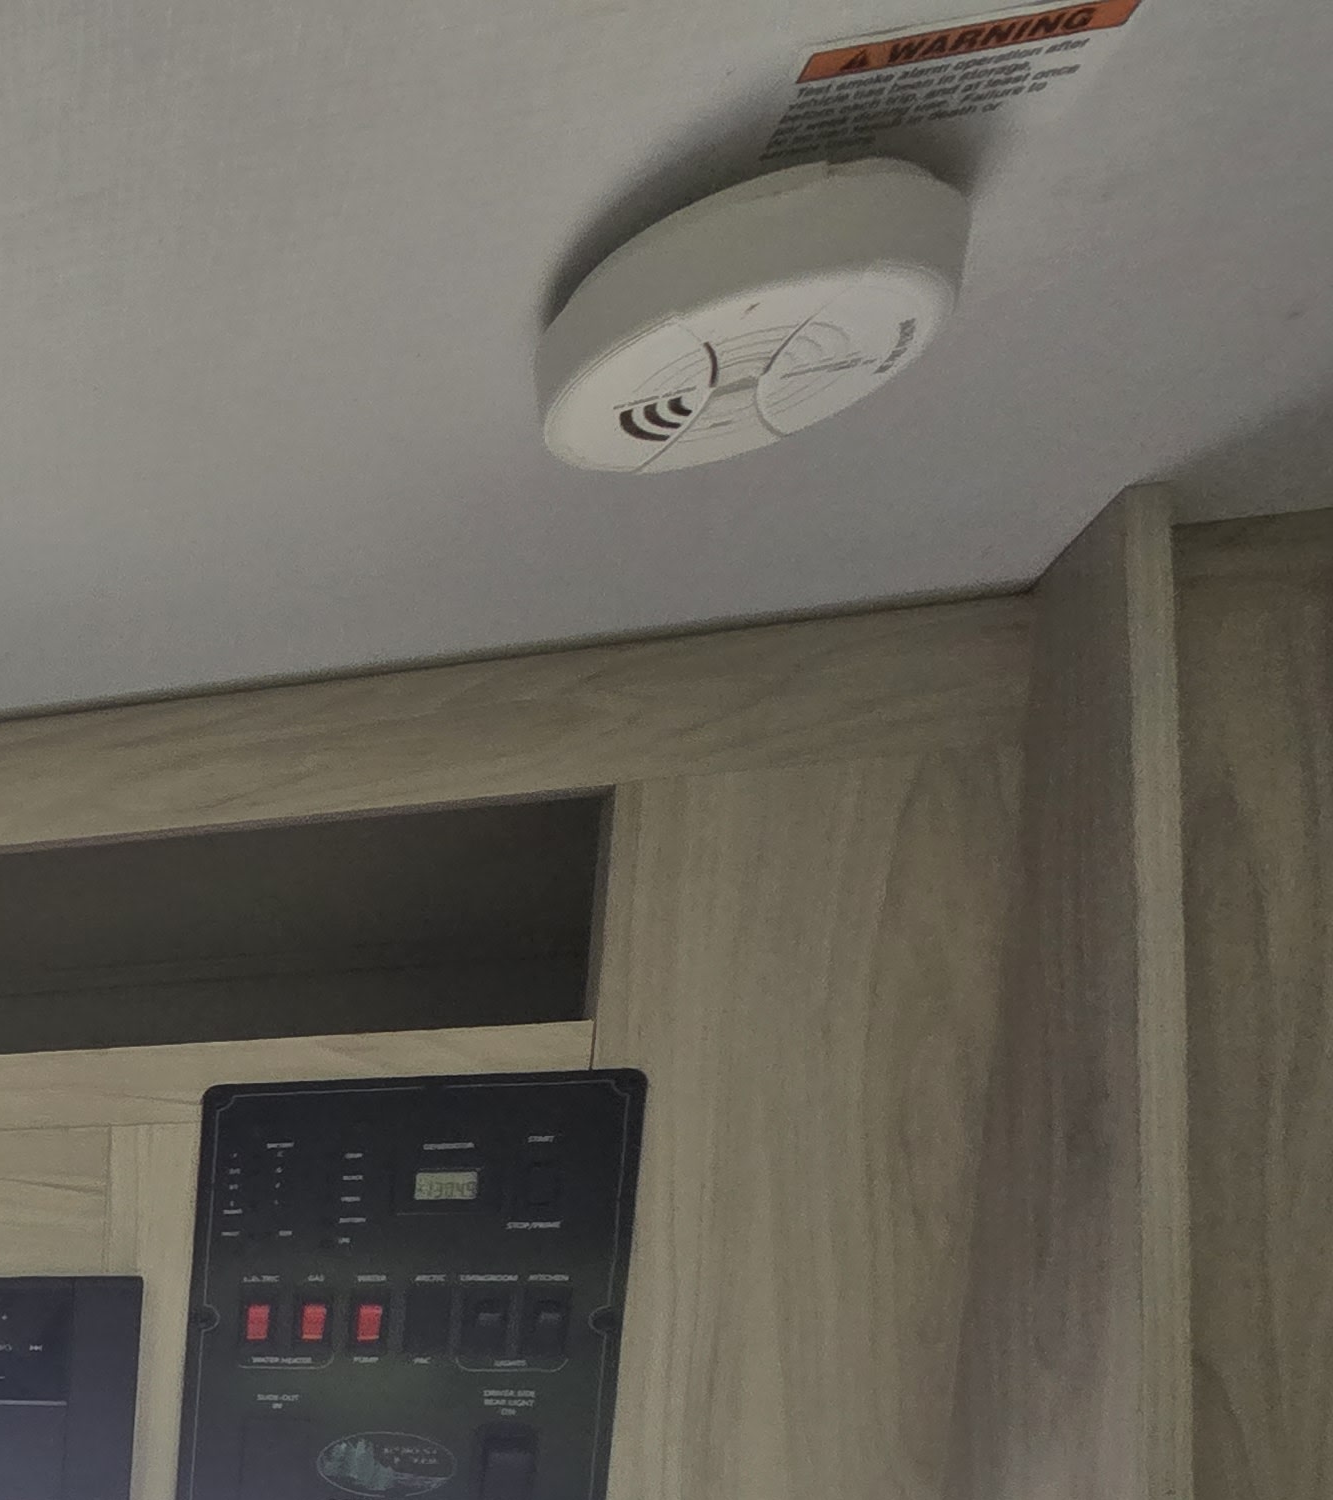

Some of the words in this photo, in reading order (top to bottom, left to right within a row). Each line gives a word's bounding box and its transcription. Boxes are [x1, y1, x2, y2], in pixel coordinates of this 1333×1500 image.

[888, 8, 1097, 63] WARNING
[836, 74, 895, 92] smoke
[897, 63, 951, 81] alarm
[953, 46, 1044, 72] operation
[1045, 38, 1091, 55] after
[937, 74, 956, 86] in
[1031, 63, 1081, 81] once
